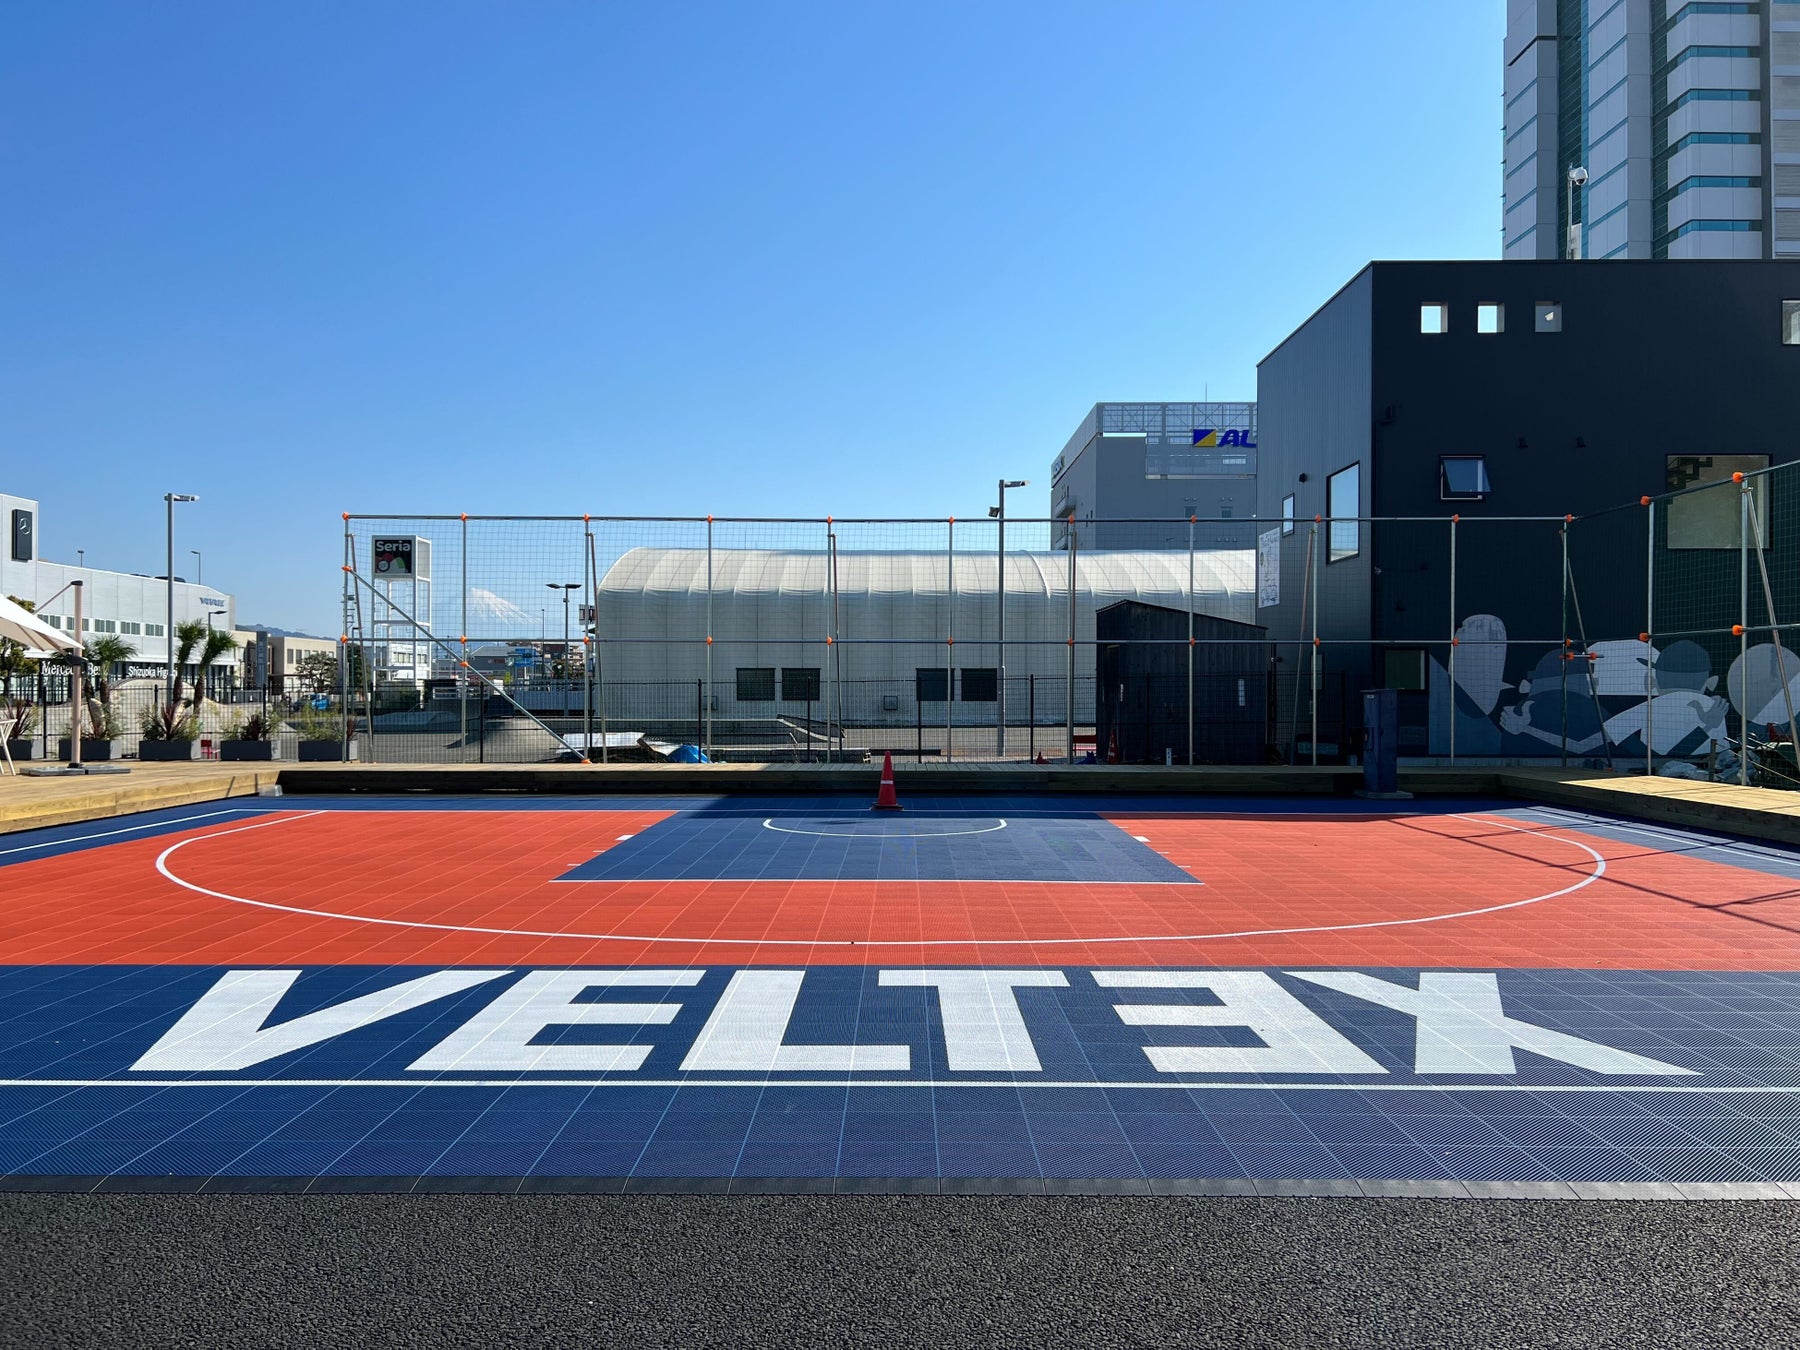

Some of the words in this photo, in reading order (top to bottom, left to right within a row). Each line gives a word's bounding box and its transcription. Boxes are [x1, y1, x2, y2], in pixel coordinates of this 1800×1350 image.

[376, 540, 411, 552] Seria
[128, 665, 156, 678] Shizuoka
[128, 969, 1704, 1077] VELTEX
